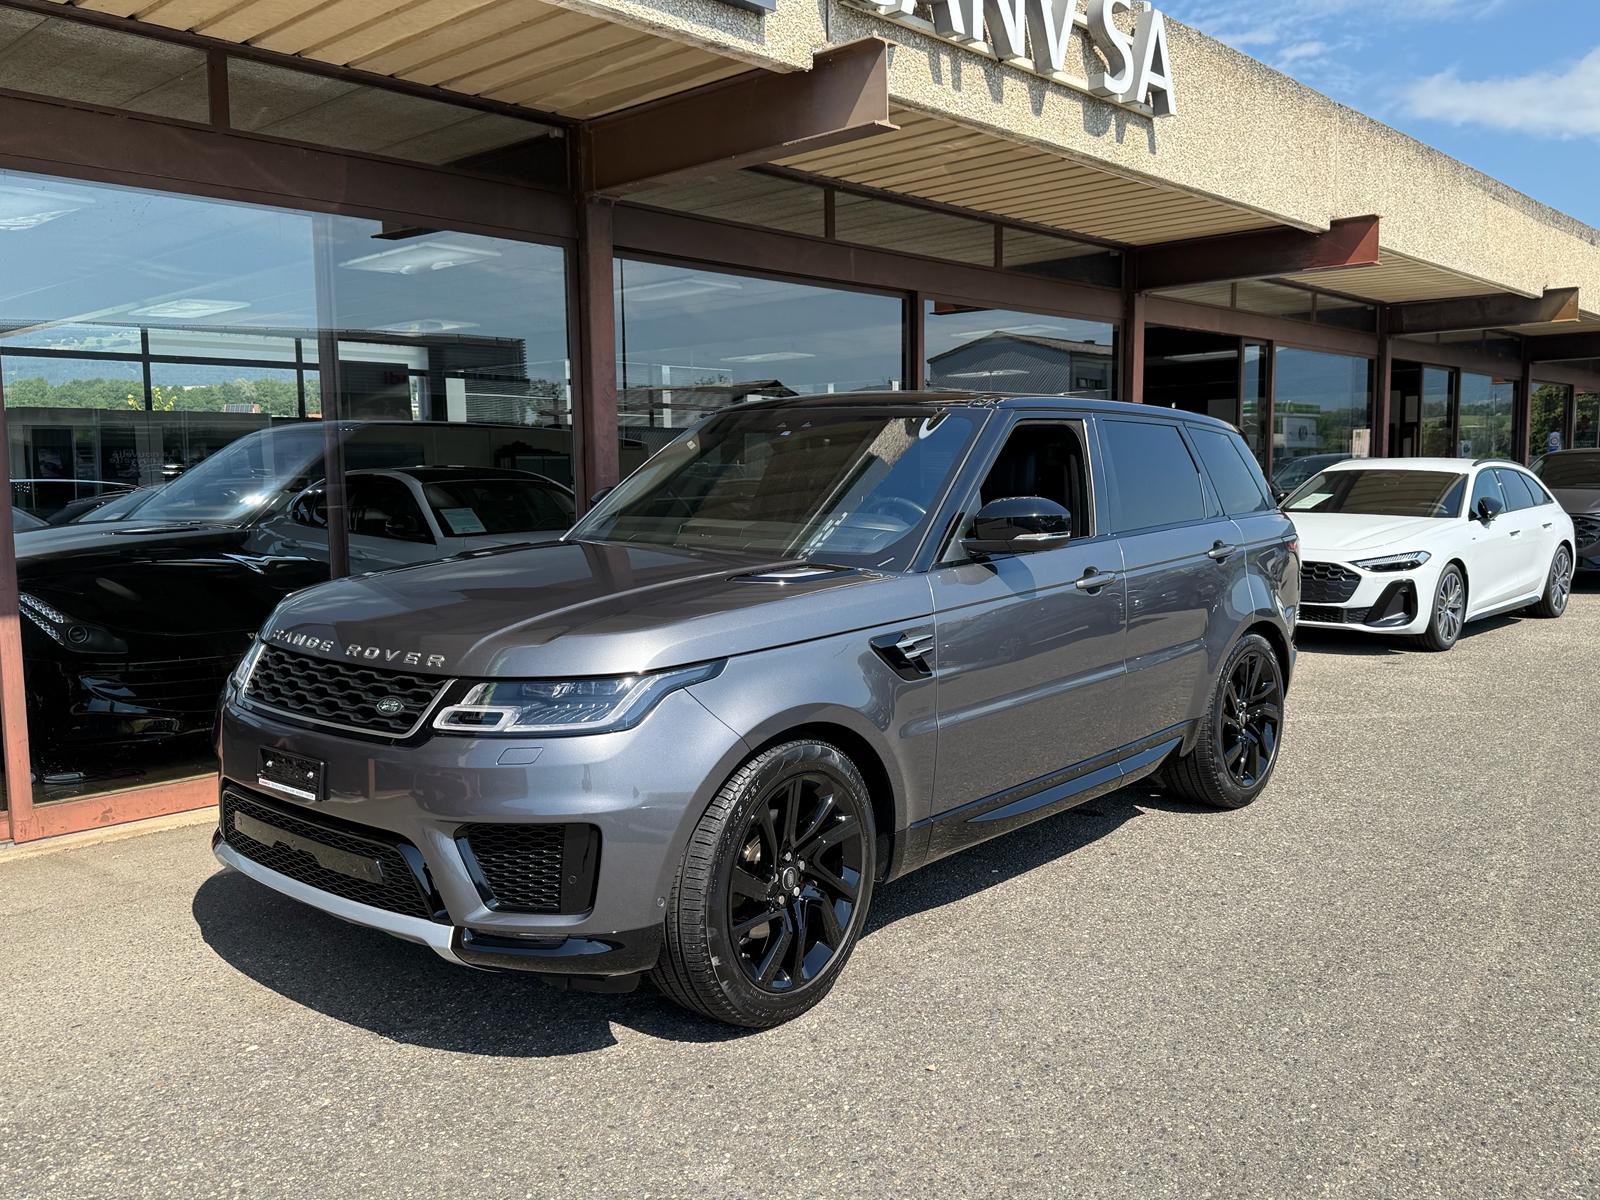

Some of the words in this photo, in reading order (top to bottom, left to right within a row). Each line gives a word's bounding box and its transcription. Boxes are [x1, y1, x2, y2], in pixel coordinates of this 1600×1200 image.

[1087, 0, 1176, 116] SA
[273, 629, 334, 652] RANGE
[345, 643, 446, 667] ROVER
